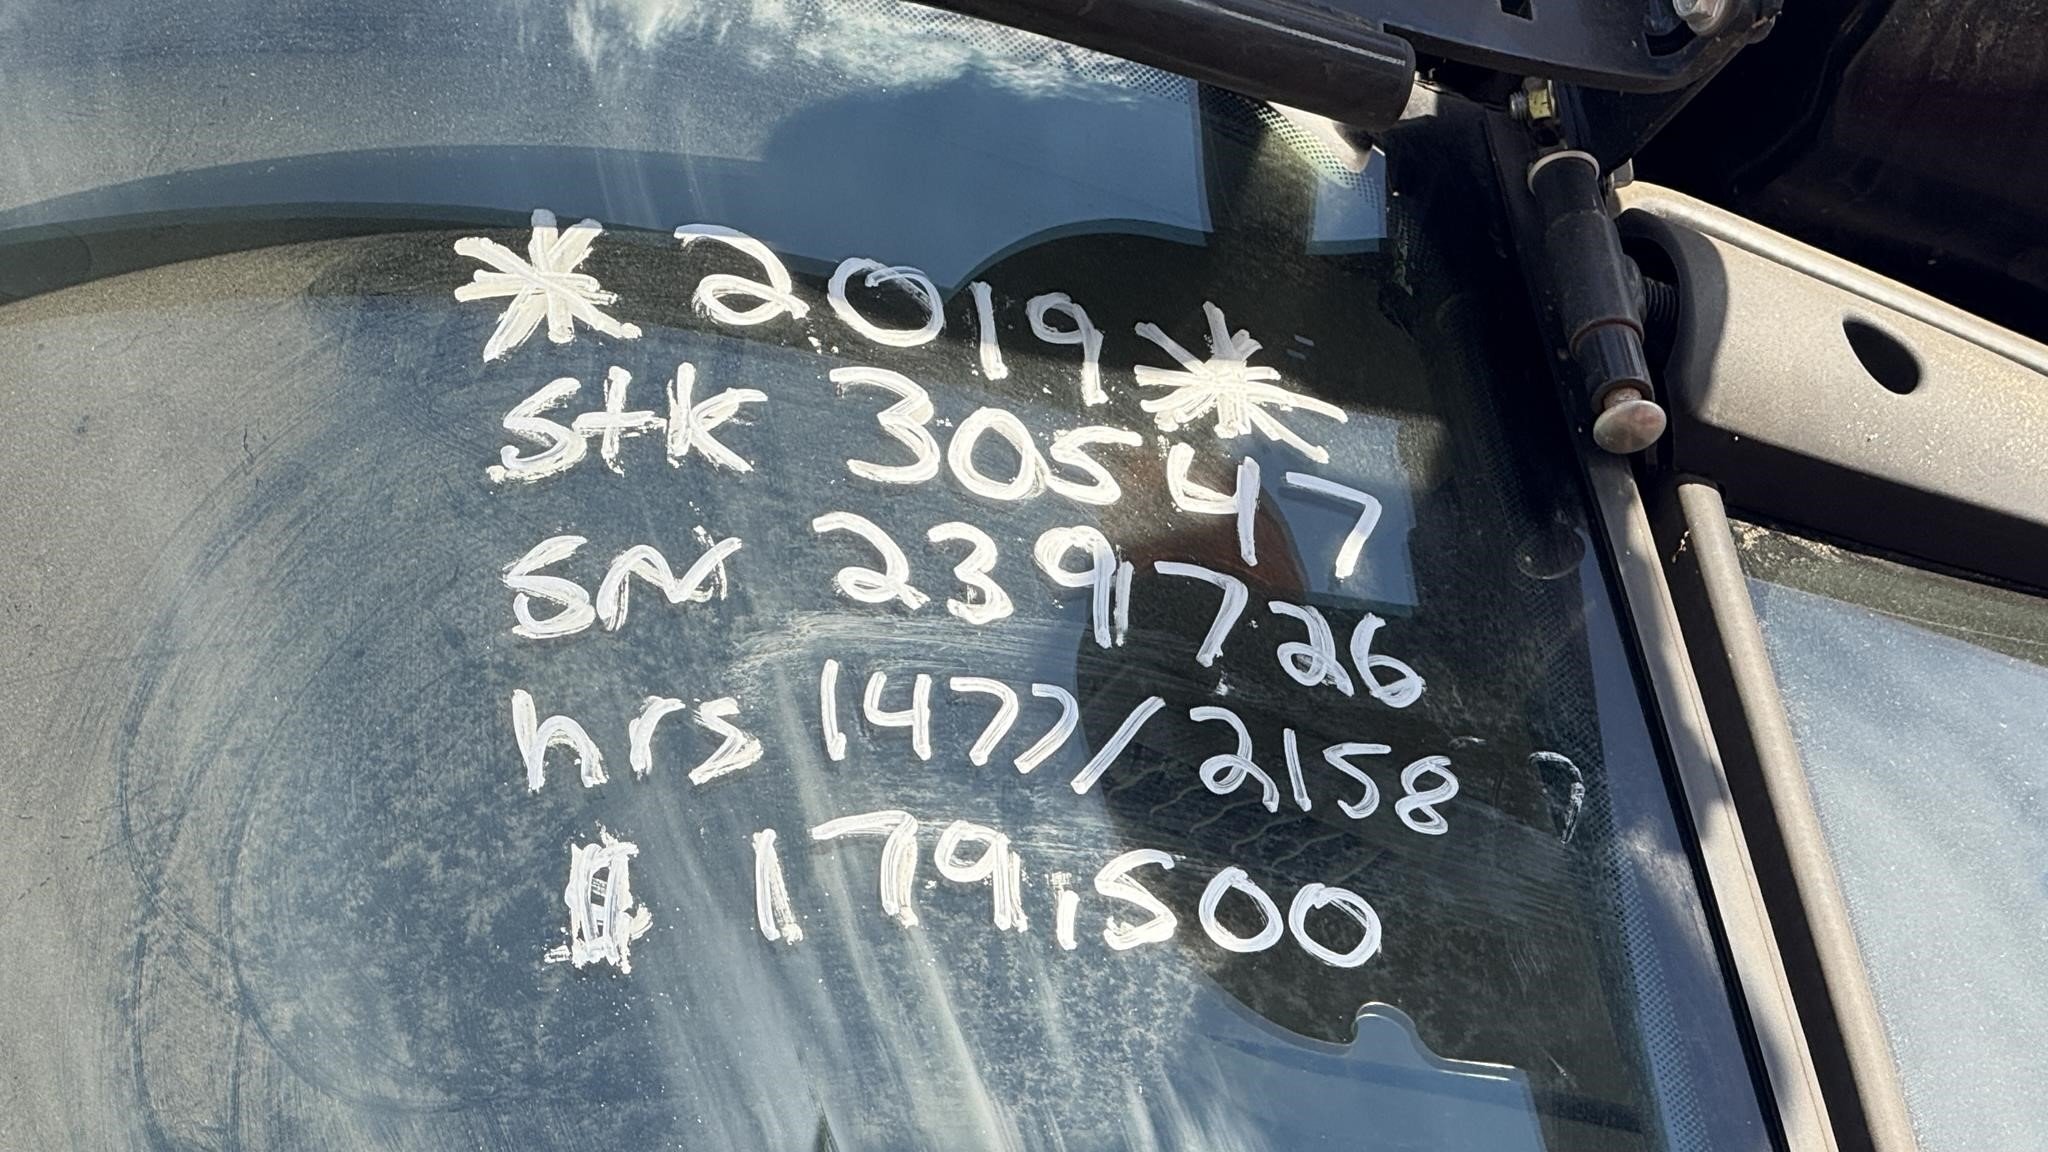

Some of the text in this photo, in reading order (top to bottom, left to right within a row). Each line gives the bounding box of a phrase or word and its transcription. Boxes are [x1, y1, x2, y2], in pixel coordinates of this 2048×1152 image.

[829, 366, 1382, 578] 30547
[812, 510, 1426, 710] 239726
[511, 688, 764, 792] hrs
